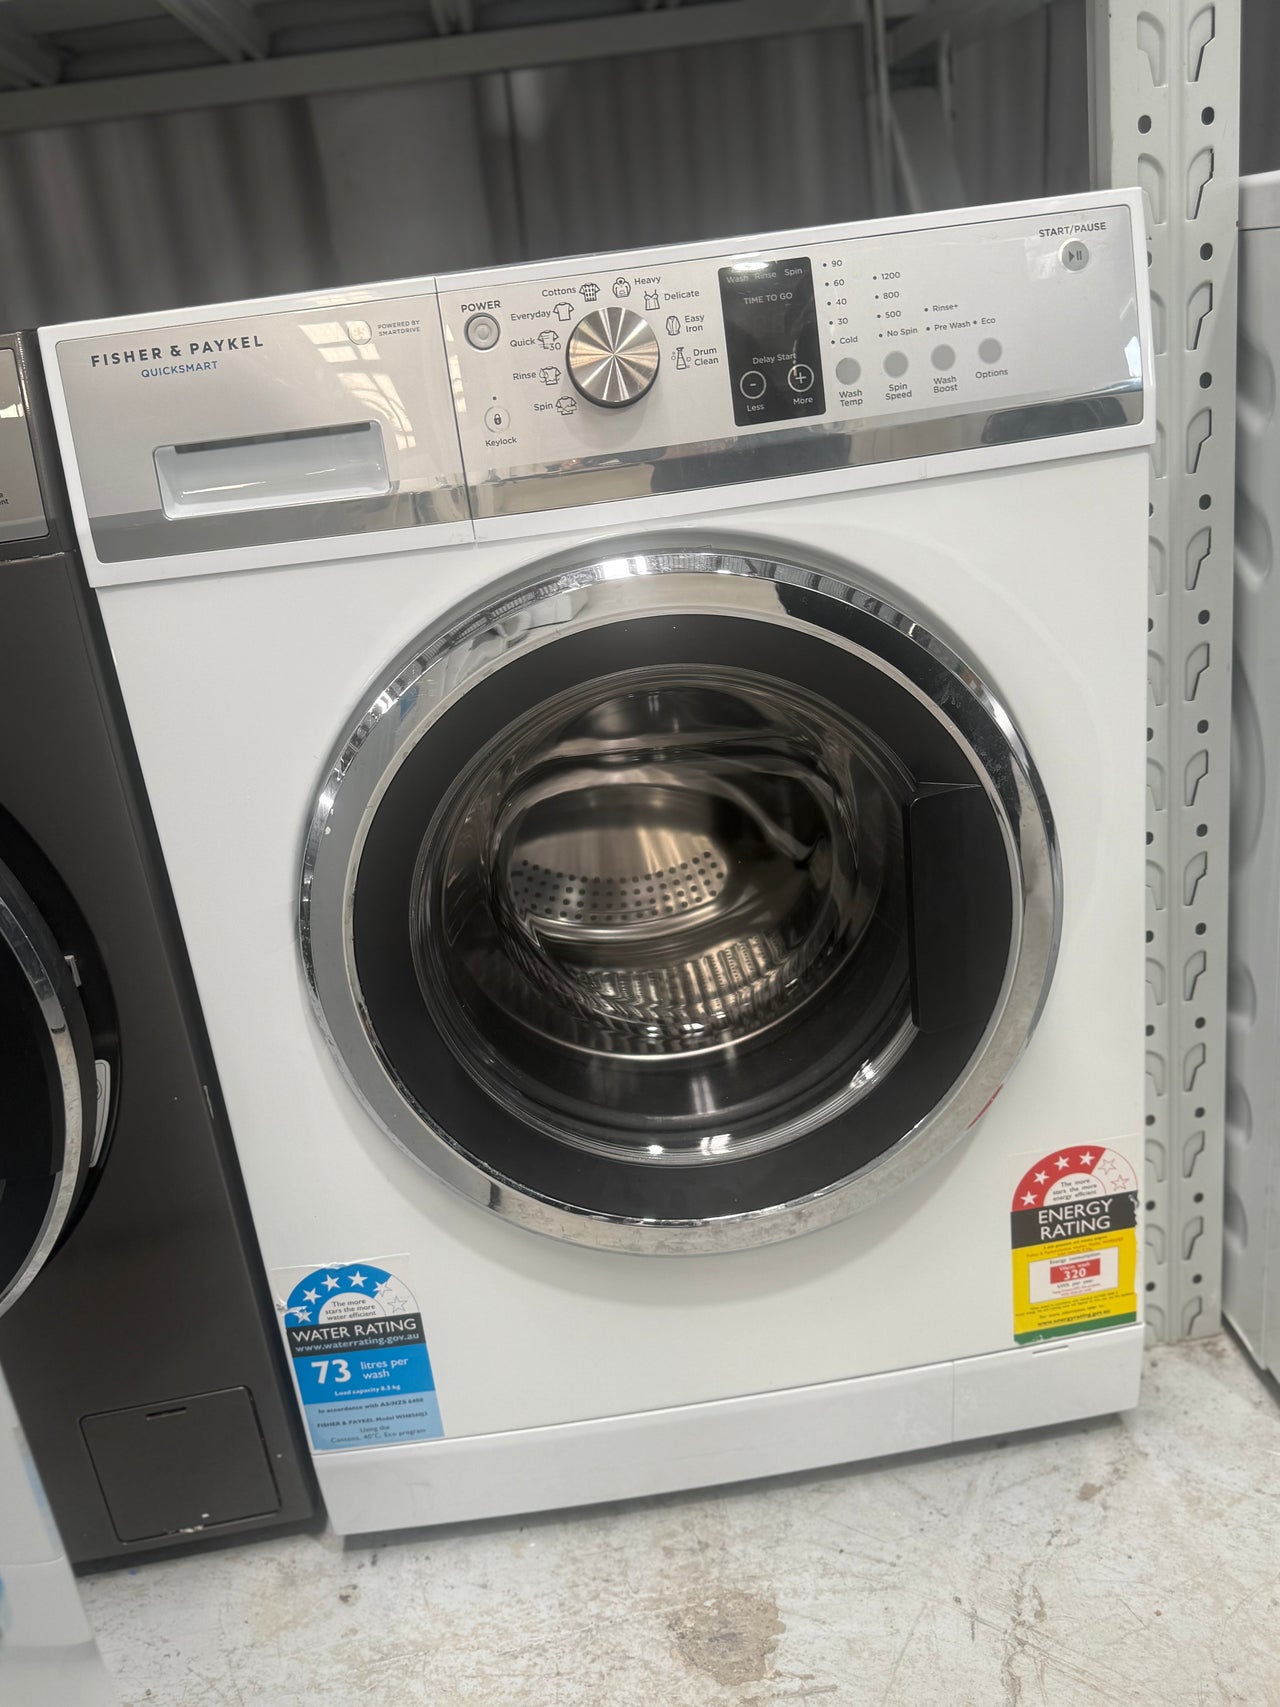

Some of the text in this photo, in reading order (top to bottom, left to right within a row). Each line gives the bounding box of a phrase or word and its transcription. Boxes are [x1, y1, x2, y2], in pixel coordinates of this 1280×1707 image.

[1038, 222, 1106, 237] START/PAUSE
[831, 260, 842, 268] 90
[634, 275, 661, 286] Heavy
[726, 267, 803, 284] Wash Rinse Spin
[881, 271, 900, 280] 1200
[833, 279, 845, 287] 60
[542, 286, 576, 297] Cottons
[664, 289, 700, 301] Delicate
[883, 290, 900, 300] 800
[744, 292, 793, 305] TIME TO GO
[835, 298, 847, 306] 40
[461, 300, 501, 313] POWER
[932, 303, 958, 313] Rinse+
[510, 309, 551, 322] Everyday
[685, 314, 705, 324] Easy
[885, 310, 901, 319] 500
[378, 321, 409, 329] POWERED
[837, 318, 848, 326] 30
[981, 316, 996, 325] Eco
[686, 324, 704, 332] Iron
[934, 320, 971, 332] Pre Wash
[379, 327, 420, 336] SMARTDRIVE
[886, 326, 918, 338] No Spin
[510, 338, 535, 348] Quick
[839, 336, 858, 345] Cold
[91, 336, 264, 367] FISHER & PAYKEL
[693, 346, 717, 357] Drum
[694, 356, 719, 366] Clean
[752, 353, 797, 366] Delay Start
[141, 360, 218, 378] QUICKSMART
[976, 368, 1008, 380] Options
[513, 371, 537, 381] Rinse
[933, 376, 957, 385] Wash
[889, 382, 908, 393] Spin
[933, 384, 958, 394] Boost
[839, 389, 863, 399] Wash
[885, 390, 912, 402] Speed
[793, 396, 813, 405] More
[840, 398, 863, 409] Temp
[534, 402, 554, 413] Spin
[746, 403, 765, 412] Less
[485, 436, 517, 448] Keylock
[1038, 1198, 1113, 1224] ENERGY
[1040, 1215, 1111, 1240] RATING
[1064, 1268, 1087, 1280] 320
[349, 1311, 376, 1319] efficient
[292, 1318, 416, 1343] WATER RATING
[295, 1332, 419, 1352] www.waterrating.gov.au
[360, 1358, 408, 1370] litres per
[311, 1359, 351, 1384] 73
[362, 1369, 390, 1379] wash
[352, 1387, 379, 1395] capacity
[326, 1405, 363, 1413] accordance
[398, 1428, 426, 1437] program
